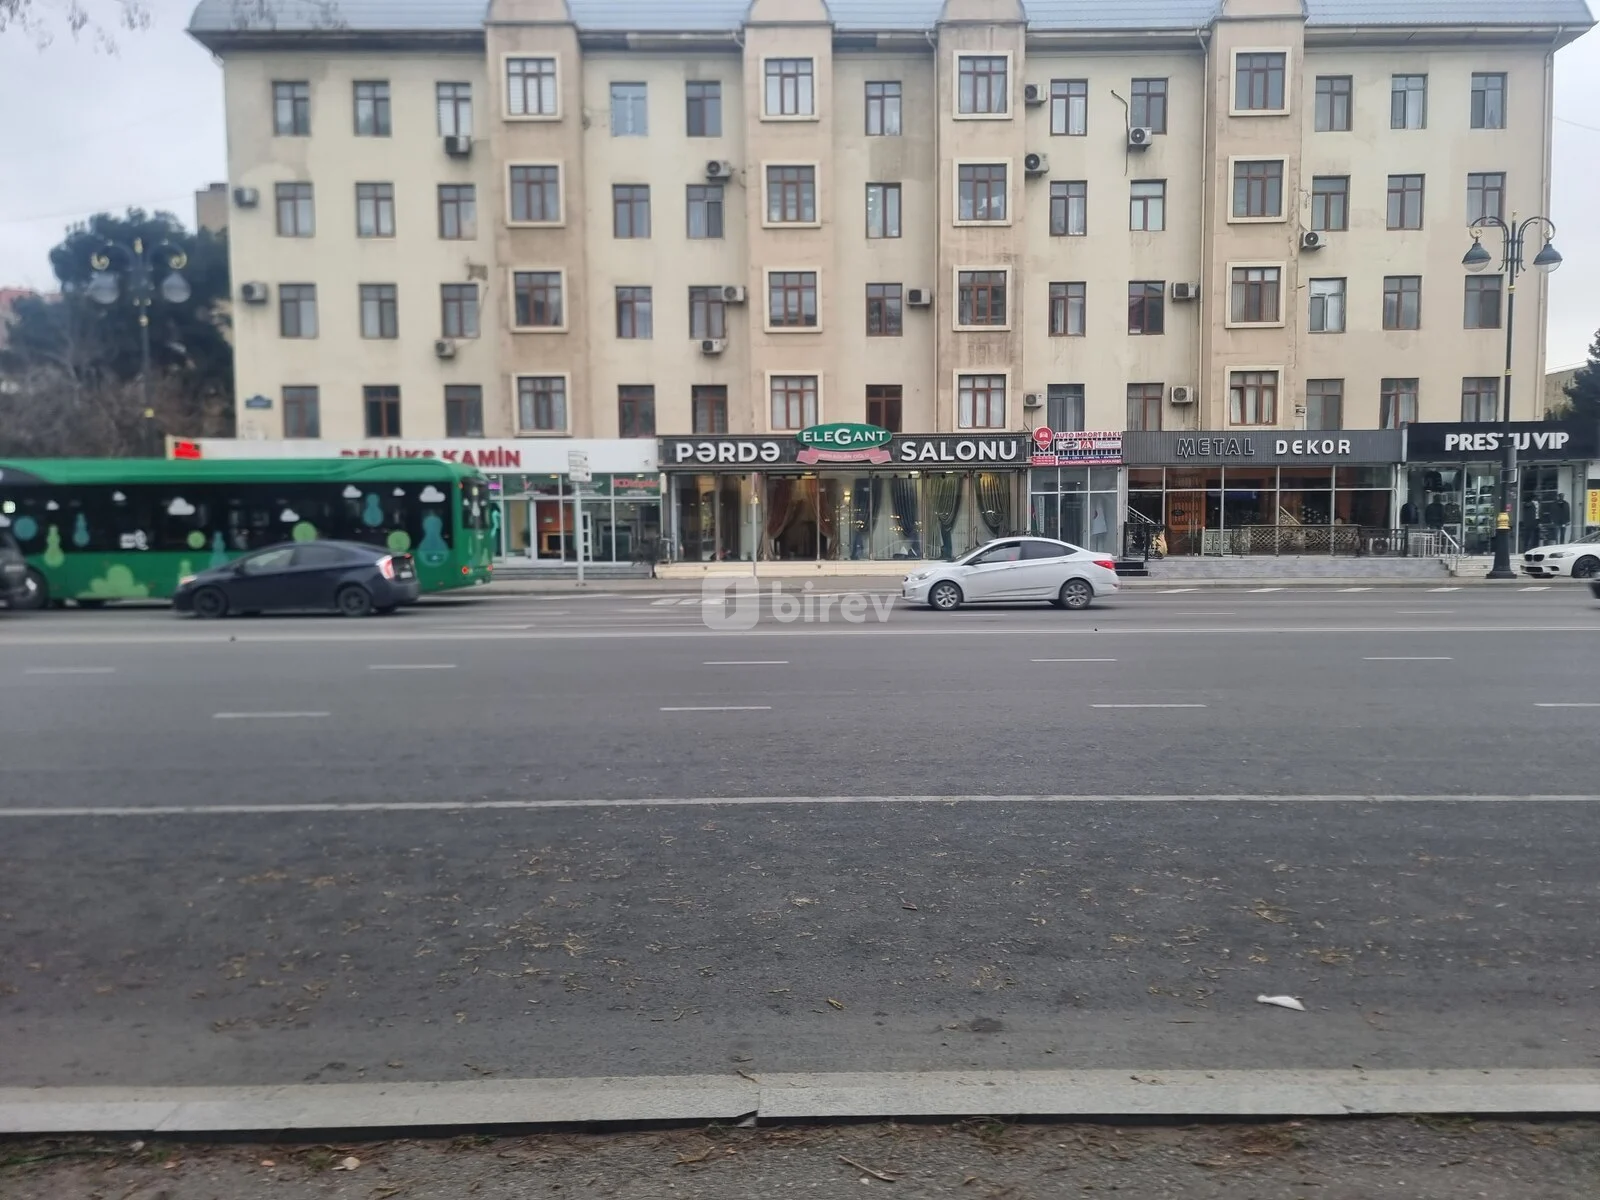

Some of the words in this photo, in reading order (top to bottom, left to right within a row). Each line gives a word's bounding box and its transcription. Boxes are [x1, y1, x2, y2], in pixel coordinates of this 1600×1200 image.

[802, 428, 886, 445] ELEGANT
[1532, 432, 1569, 450] VIP
[676, 441, 780, 463] PƏRDƏ
[900, 440, 1017, 461] SALONU
[1177, 438, 1255, 458] METAL
[1275, 439, 1351, 455] DEKOR
